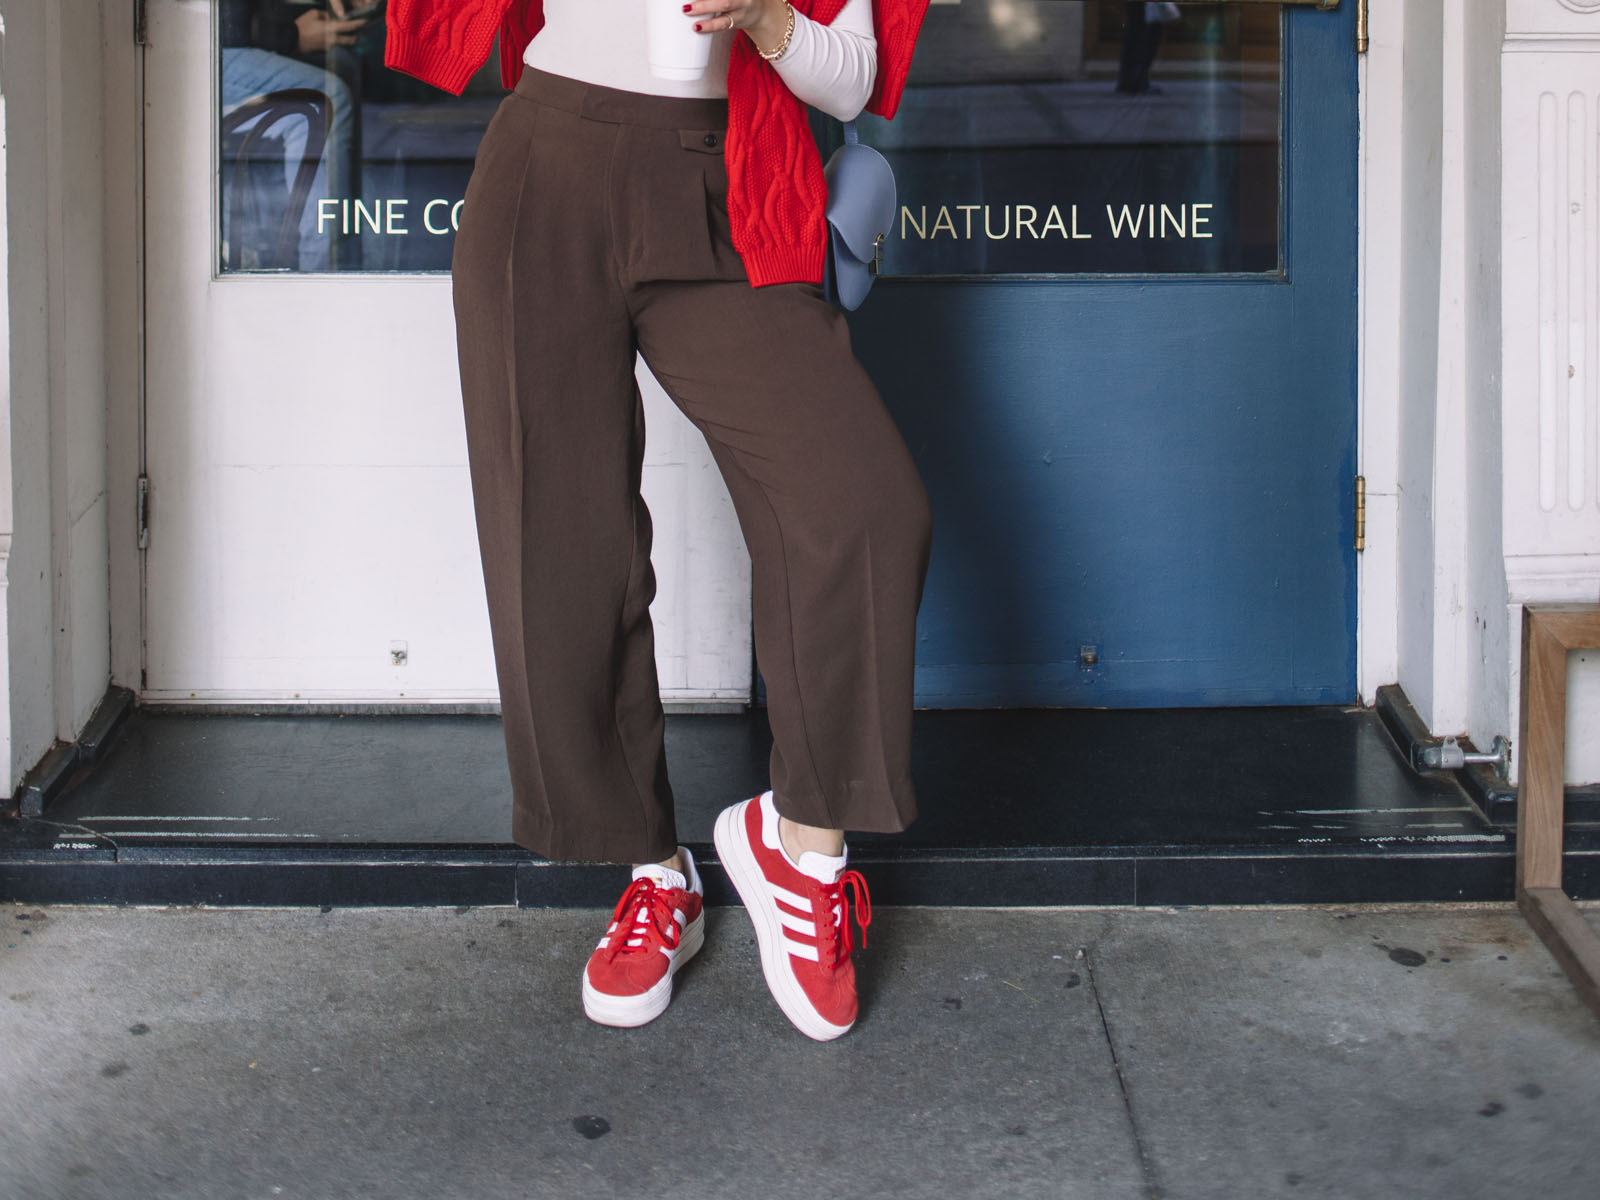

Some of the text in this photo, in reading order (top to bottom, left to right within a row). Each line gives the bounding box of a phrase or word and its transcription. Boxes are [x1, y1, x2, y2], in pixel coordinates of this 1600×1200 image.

[317, 198, 409, 235] FINE
[901, 203, 1213, 240] NATURAL WINE
